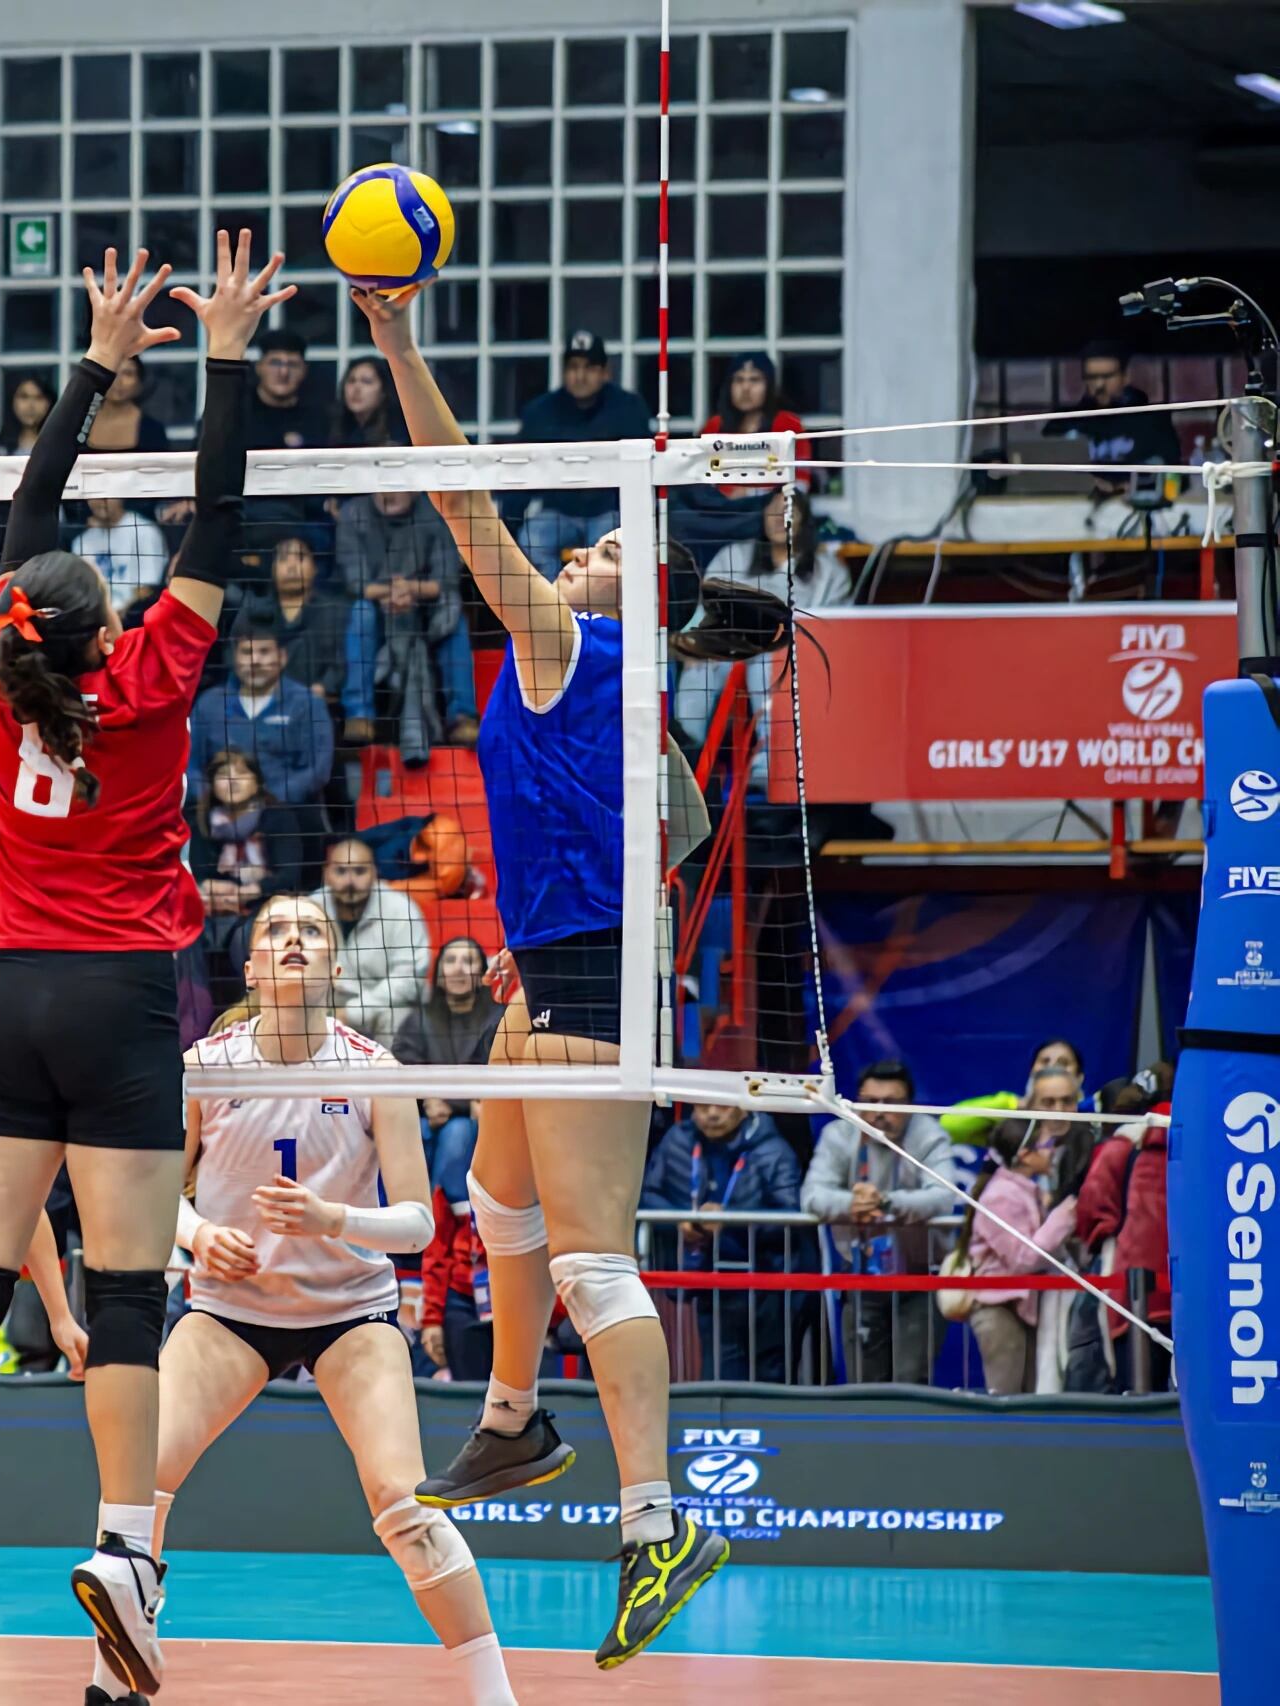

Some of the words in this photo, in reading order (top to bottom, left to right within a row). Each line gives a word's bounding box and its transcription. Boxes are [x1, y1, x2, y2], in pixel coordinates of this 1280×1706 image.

[1121, 623, 1185, 650] FIVB
[1017, 738, 1069, 768] U17
[1076, 738, 1170, 767] WORLD
[273, 1138, 297, 1182] 1
[1226, 1162, 1277, 1404] Senoh
[683, 1429, 761, 1445] FIVB
[561, 1504, 620, 1523] U17
[756, 1508, 1004, 1531] CHAMPIONSHIP
